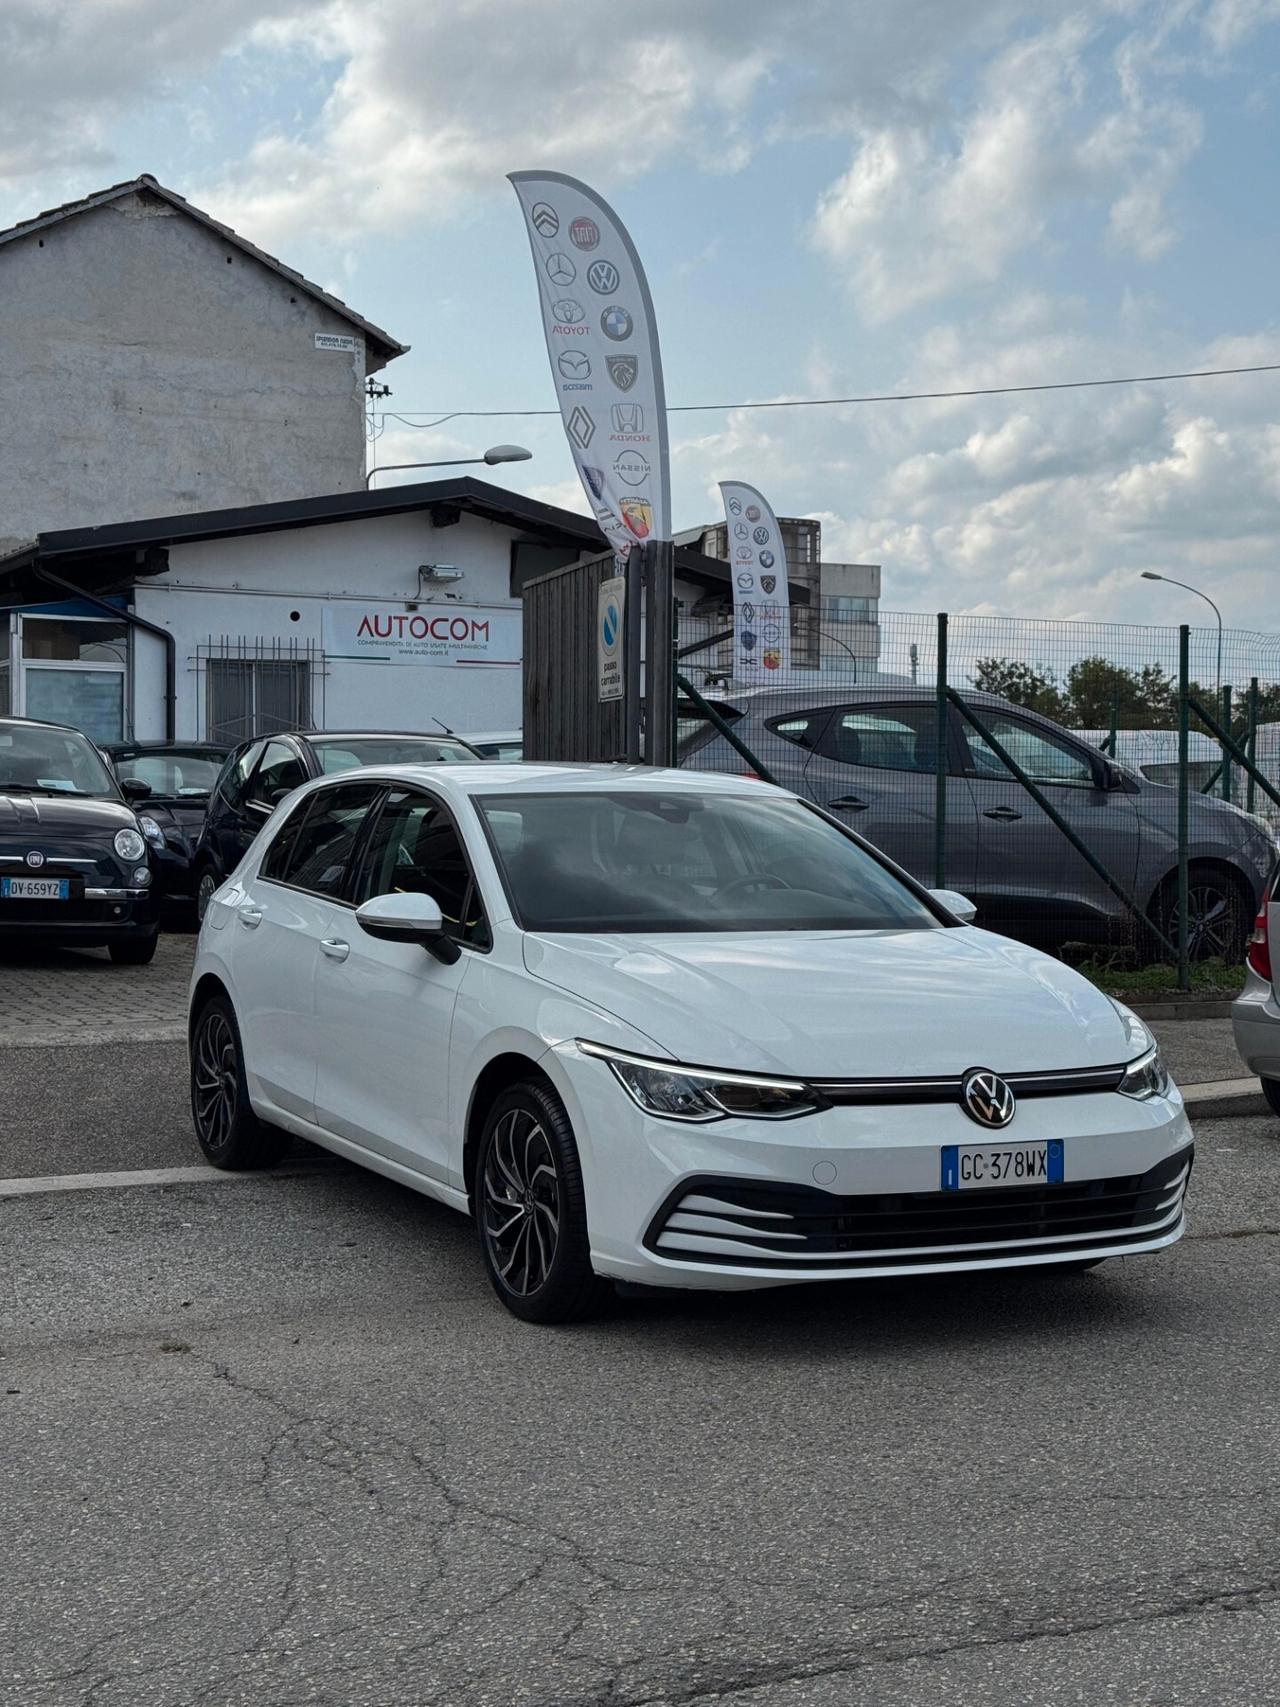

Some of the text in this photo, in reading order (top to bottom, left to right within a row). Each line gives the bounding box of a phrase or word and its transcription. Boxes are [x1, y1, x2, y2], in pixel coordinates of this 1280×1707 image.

[356, 615, 489, 642] AUTOCOM
[405, 640, 412, 648] DI
[398, 649, 449, 657] www.auto-com.it
